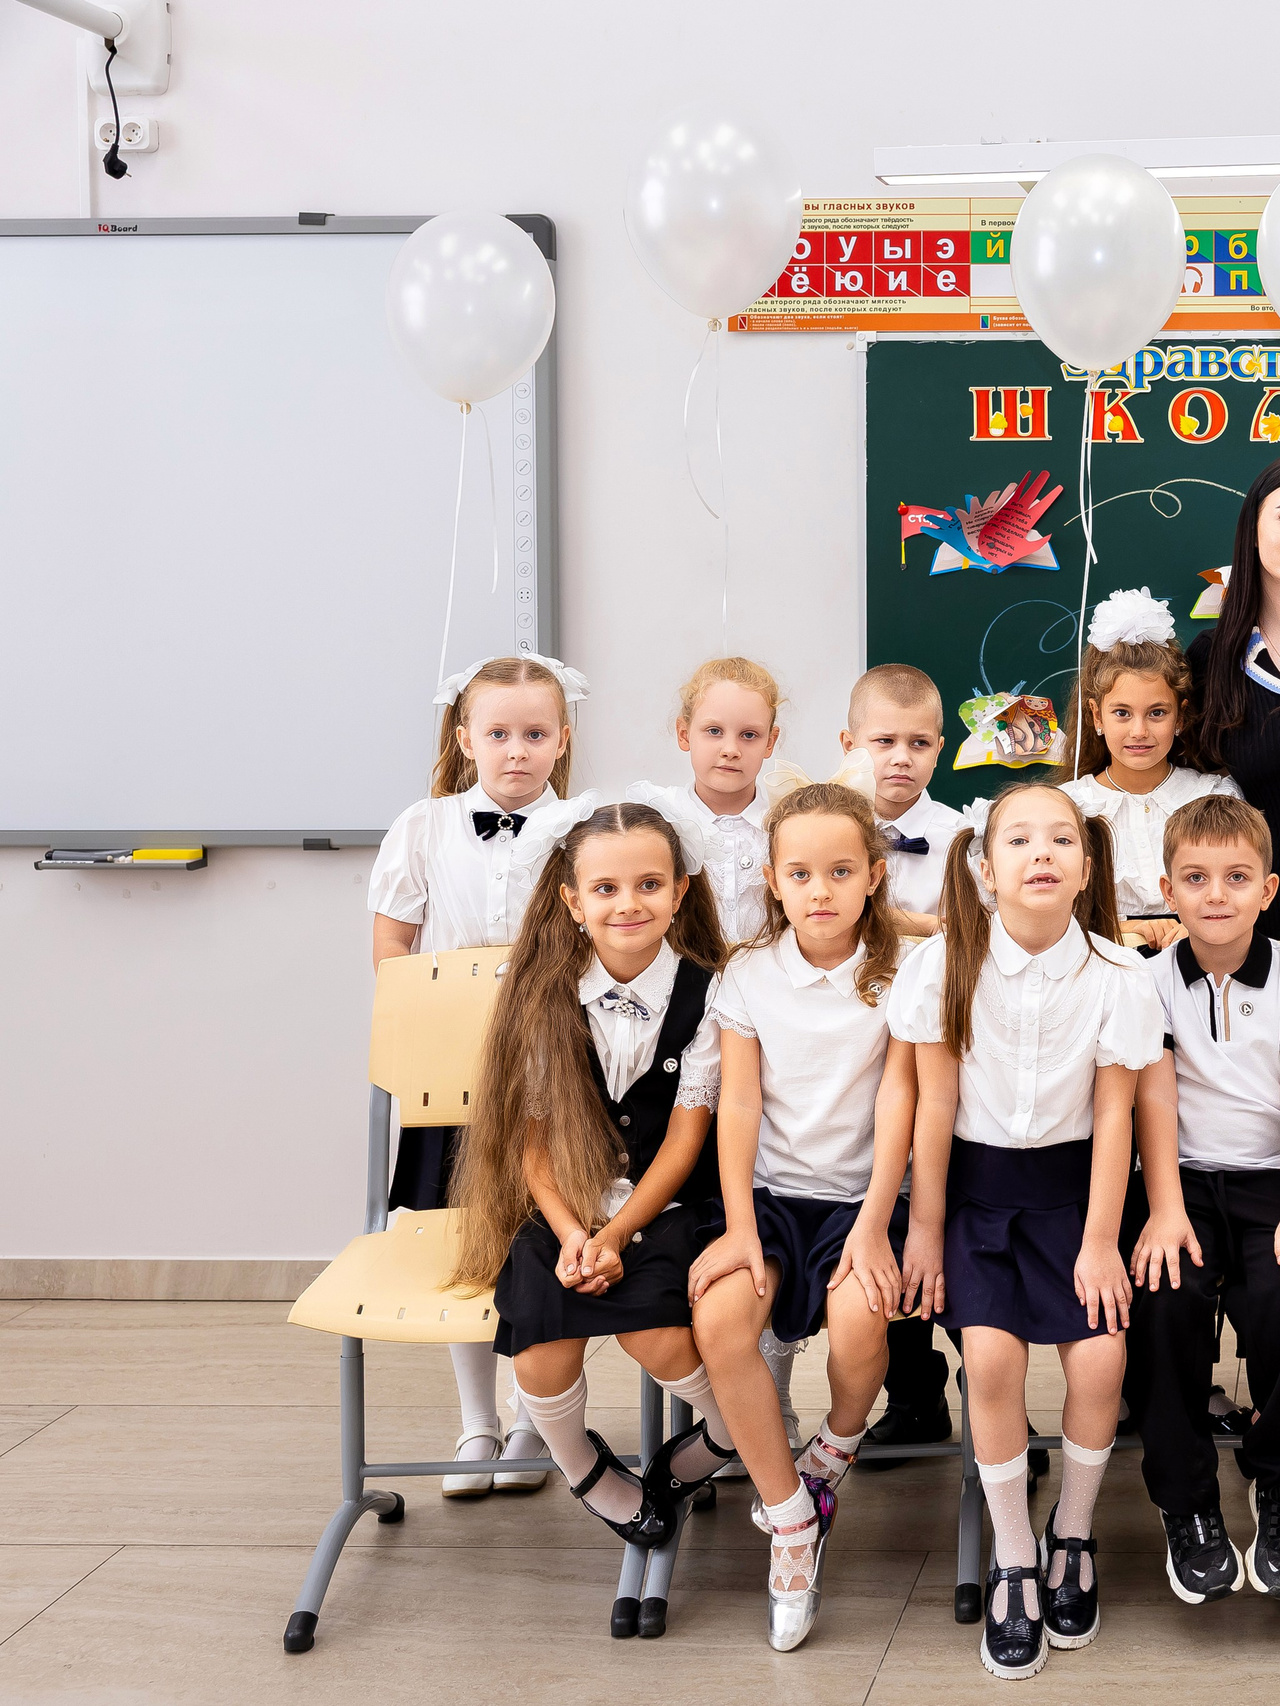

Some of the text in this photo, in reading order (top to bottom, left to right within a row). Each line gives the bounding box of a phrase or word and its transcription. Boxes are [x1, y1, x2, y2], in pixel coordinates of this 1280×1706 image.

[823, 202, 915, 212] гласных звуков
[838, 236, 857, 262] у
[884, 238, 911, 259] ы
[936, 238, 955, 259] э
[986, 232, 1004, 258] й
[1228, 233, 1248, 259] б
[790, 266, 955, 293] ё ю и е
[1230, 270, 1248, 290] п
